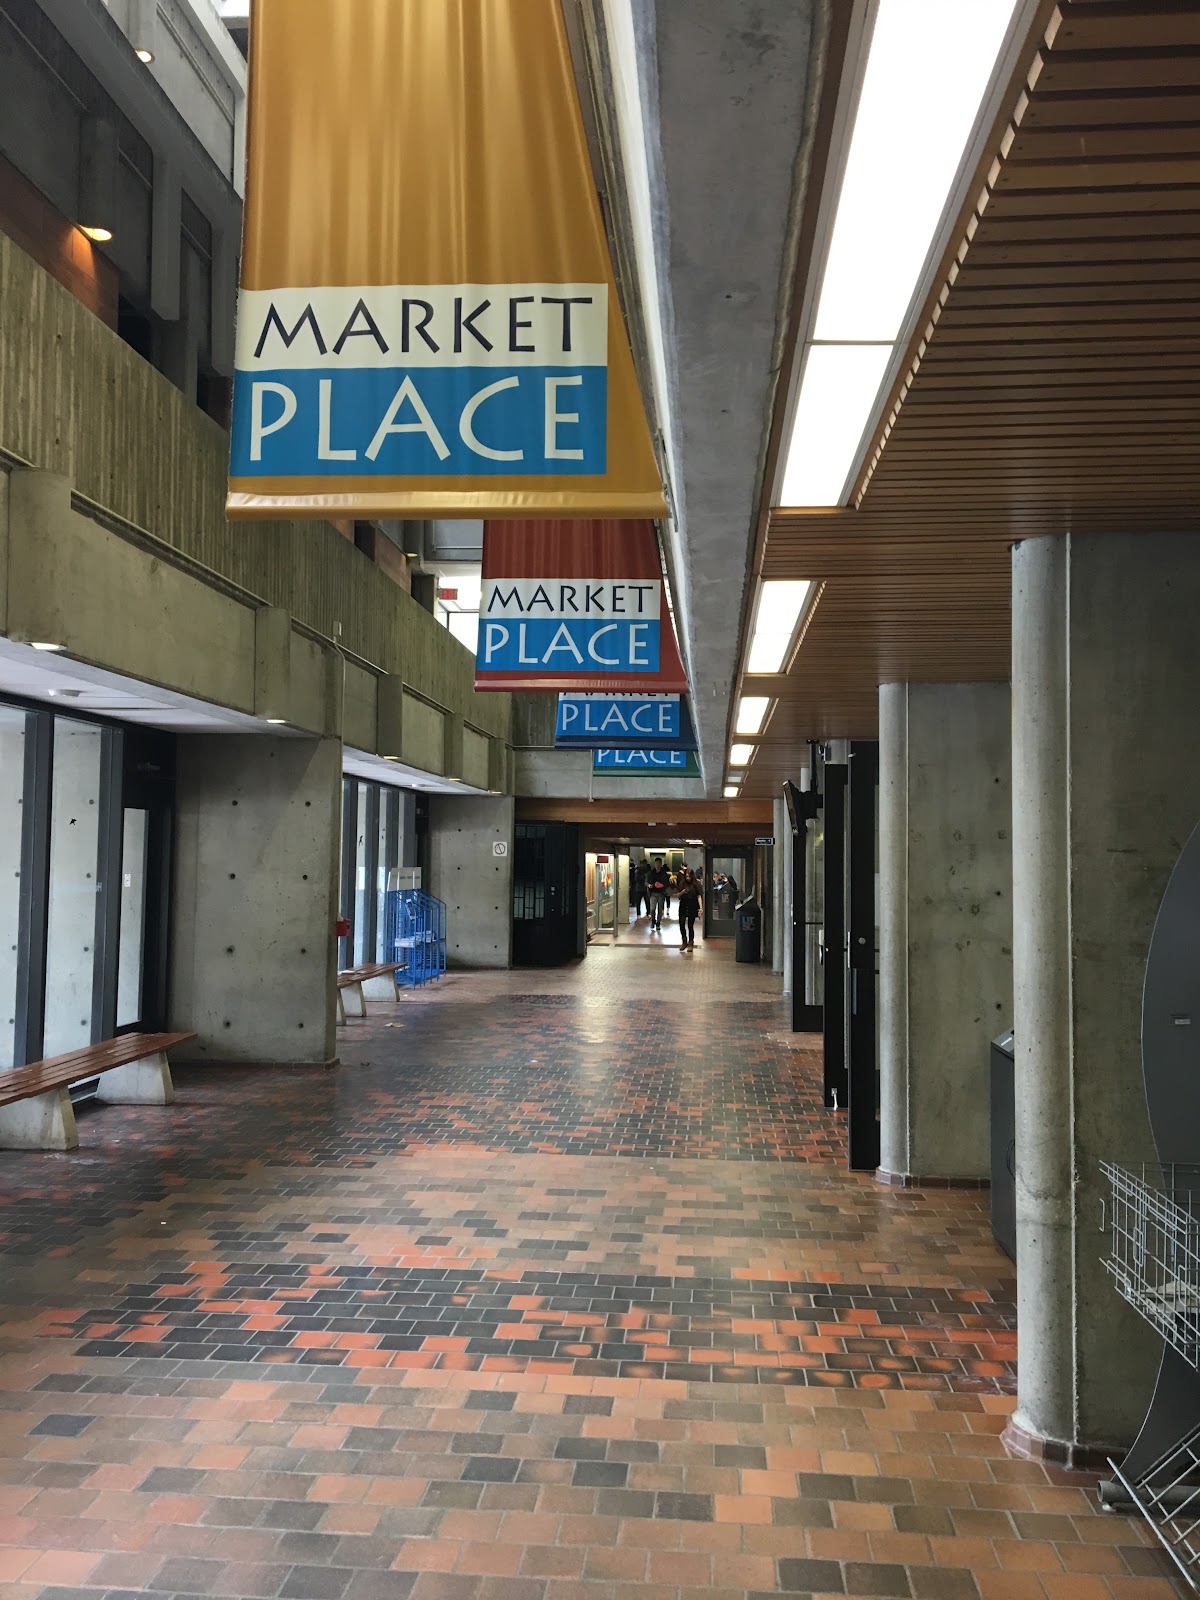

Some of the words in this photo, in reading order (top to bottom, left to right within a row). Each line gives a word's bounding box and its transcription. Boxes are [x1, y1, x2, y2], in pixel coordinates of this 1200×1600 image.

[253, 296, 593, 359] MARKET
[249, 374, 584, 462] PLACE
[487, 584, 653, 613] MARKET
[485, 622, 649, 665] PLACE
[562, 702, 673, 733] PLACE
